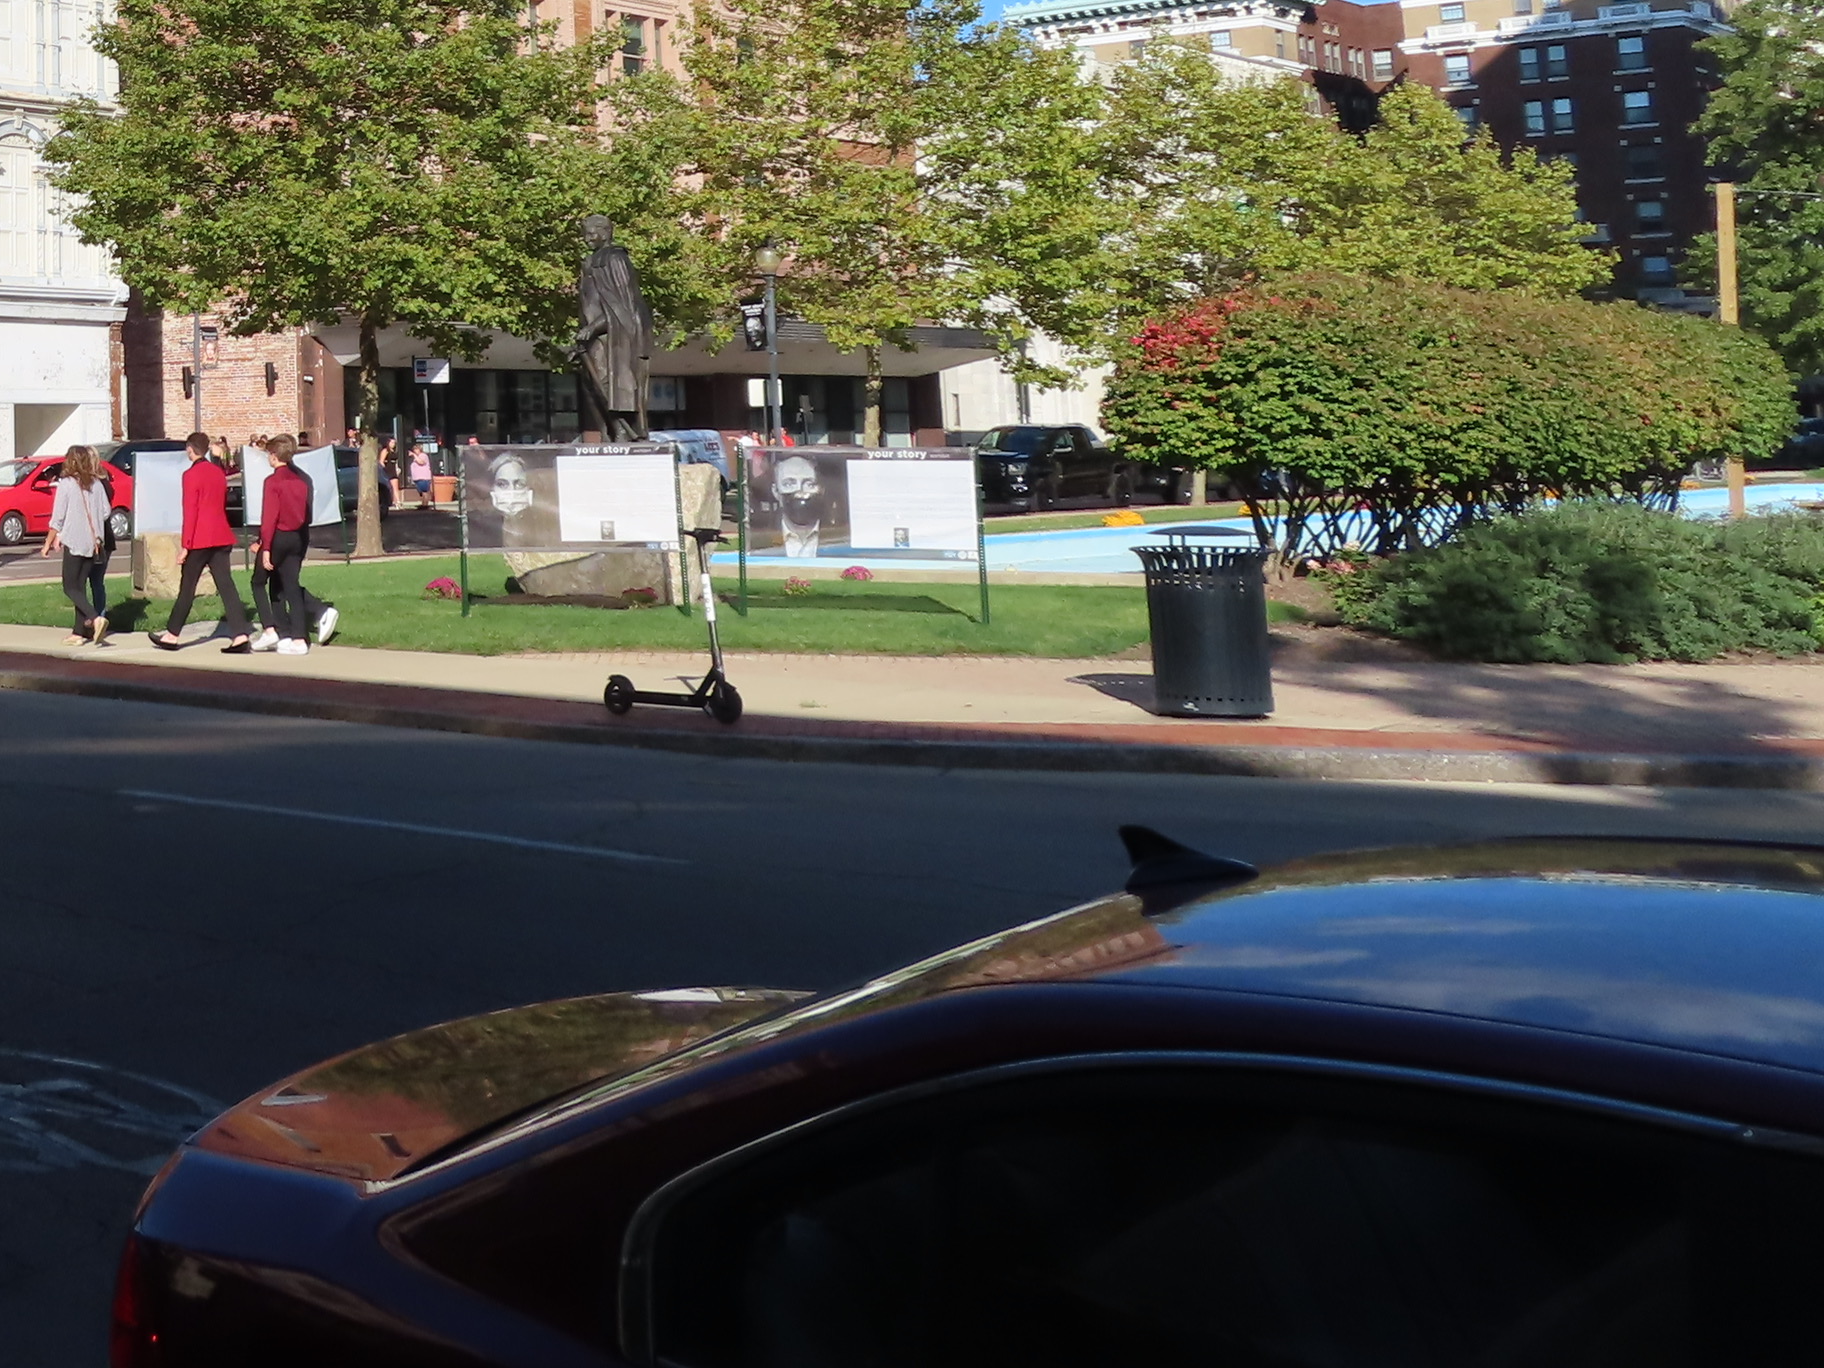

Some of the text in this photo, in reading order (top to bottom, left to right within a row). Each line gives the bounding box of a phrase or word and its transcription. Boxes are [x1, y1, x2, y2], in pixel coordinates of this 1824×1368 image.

[575, 446, 600, 455] your
[603, 445, 631, 455] story
[867, 450, 893, 459] your
[897, 450, 927, 460] story
